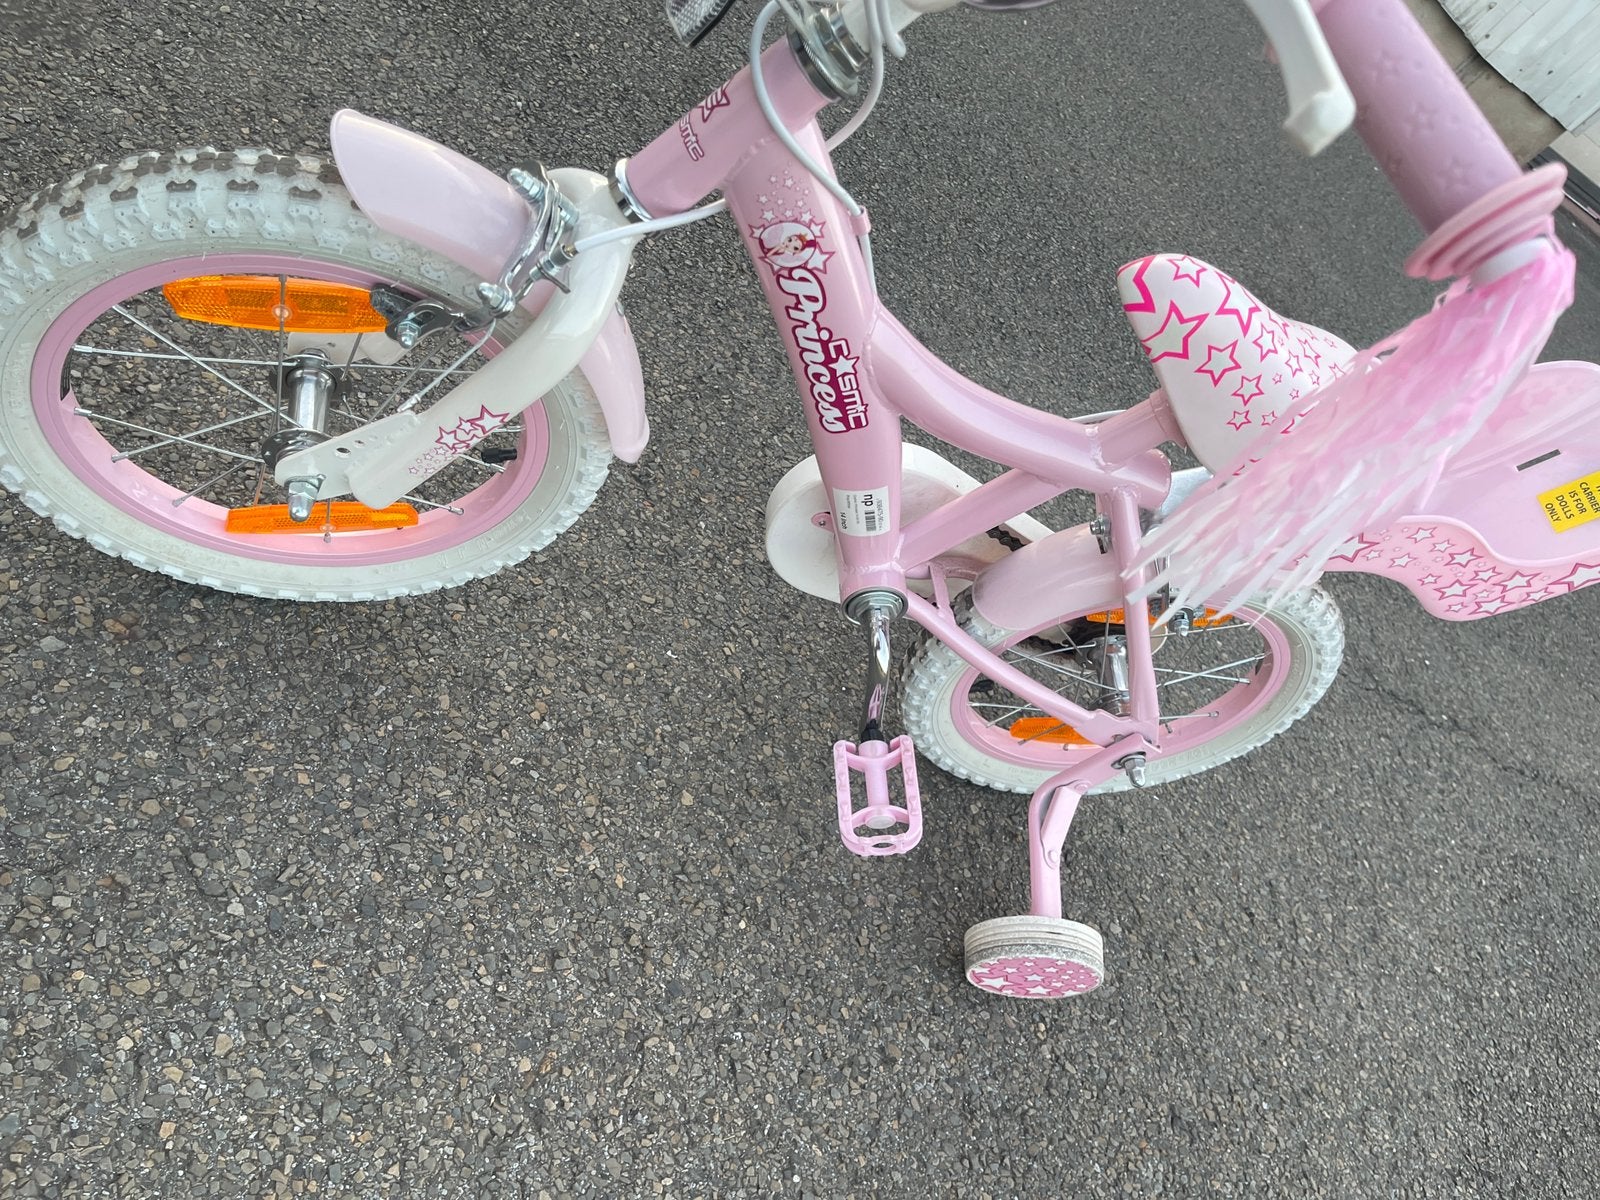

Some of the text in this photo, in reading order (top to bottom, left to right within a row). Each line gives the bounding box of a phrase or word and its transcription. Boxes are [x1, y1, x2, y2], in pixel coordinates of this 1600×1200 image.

[776, 267, 849, 434] Princess
[861, 494, 874, 506] np
[1555, 494, 1575, 520] DOLLS
[1569, 490, 1587, 515] IS FOR
[1579, 481, 1600, 514] CARRIER
[1545, 503, 1562, 522] ONLY
